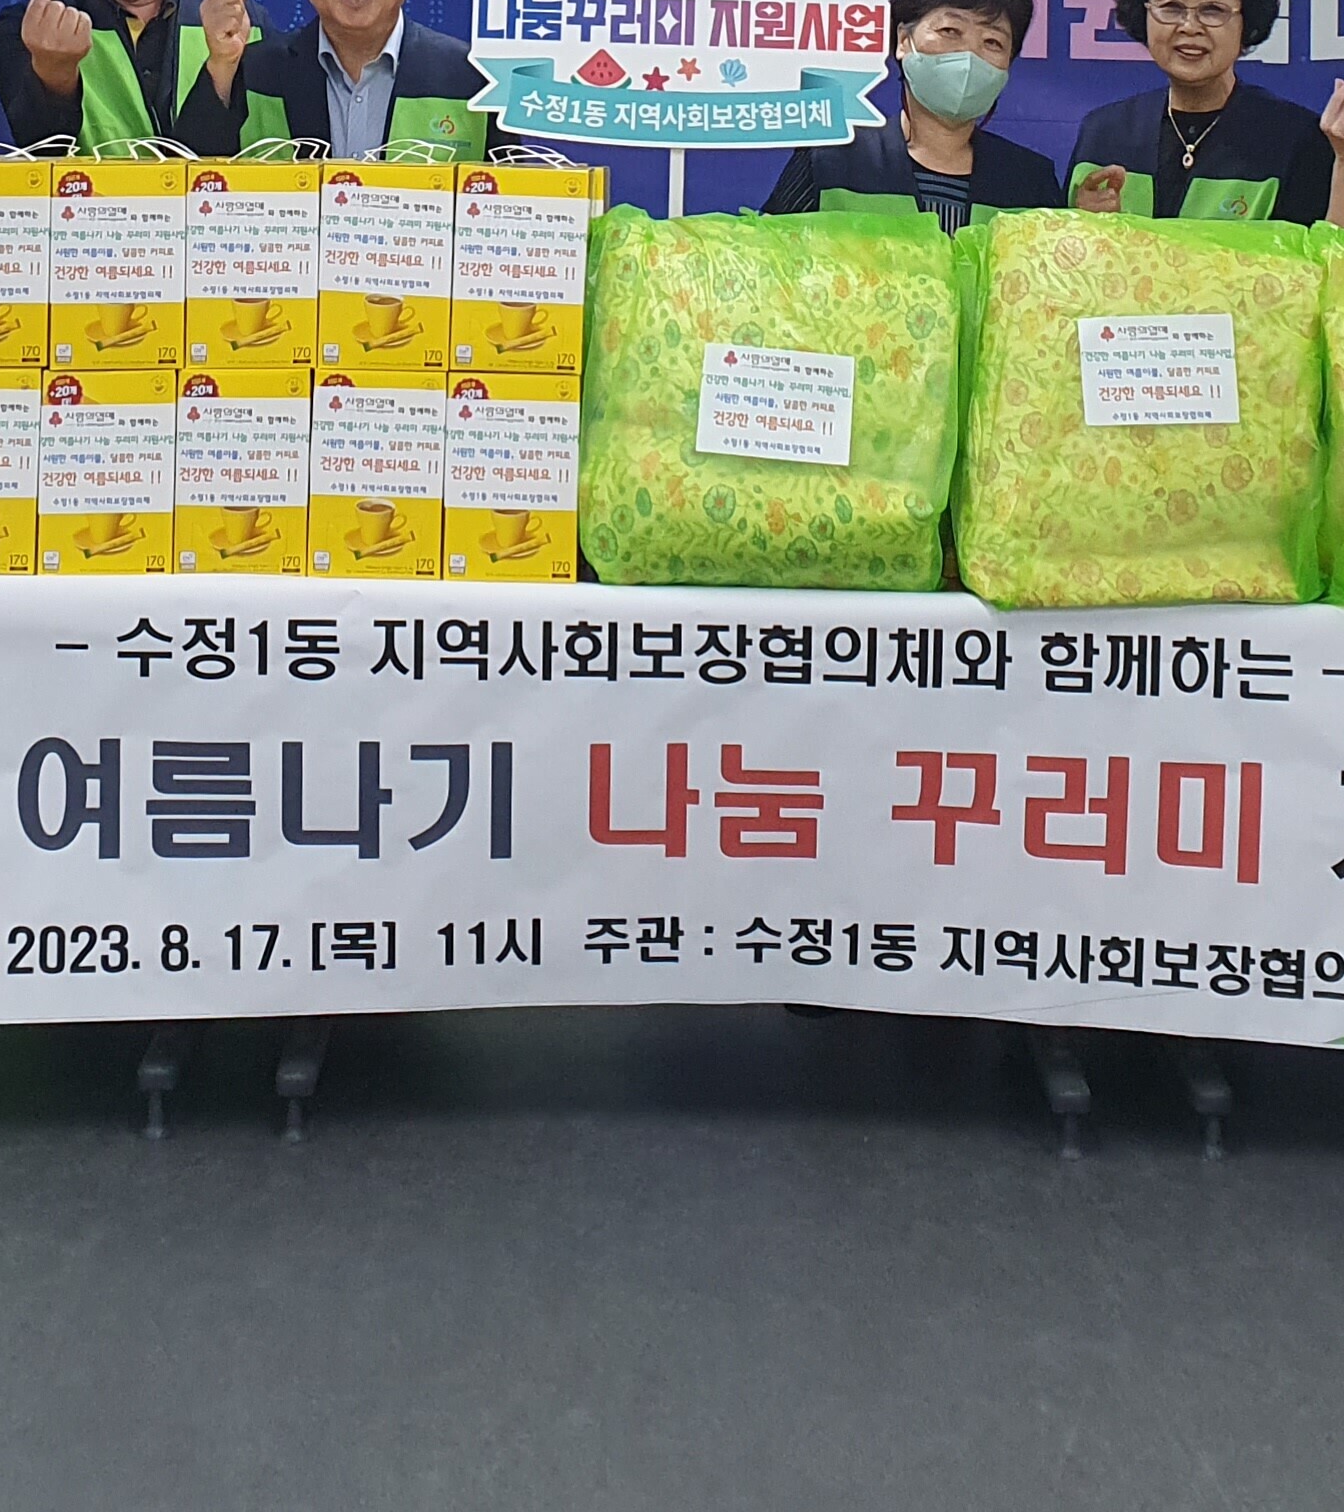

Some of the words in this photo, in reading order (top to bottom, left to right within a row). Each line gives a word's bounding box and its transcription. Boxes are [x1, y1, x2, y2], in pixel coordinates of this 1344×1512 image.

[708, 0, 885, 52] 지원사업
[520, 91, 607, 127] 수정1동
[615, 98, 832, 130] 지역사회보장협의체
[326, 250, 359, 265] 건강한
[55, 265, 89, 281] 건강한
[193, 260, 226, 275] 건강한
[459, 262, 492, 277] 건강한
[21, 346, 42, 358] 170
[157, 347, 178, 359] 170
[292, 347, 313, 359] 170
[423, 350, 444, 362] 170
[556, 354, 577, 366] 170
[1099, 387, 1135, 402] 건강한
[714, 411, 748, 427] 건강한
[756, 415, 815, 432] 여름되세요
[321, 457, 355, 471] 건강한
[43, 471, 77, 488] 건강한
[180, 467, 214, 482] 건강한
[452, 466, 485, 480] 건강한
[9, 555, 30, 567] 170
[145, 556, 166, 568] 170
[281, 556, 302, 568] 170
[415, 559, 436, 571] 170
[551, 562, 572, 574] 170
[117, 618, 340, 681] 수정1동
[371, 618, 1013, 690] 지역사회보장협의체와
[1041, 632, 1293, 701] 함께하는
[18, 737, 512, 859] 여름나기
[589, 743, 824, 858] 나눔
[892, 751, 1263, 884] 꾸러미
[7, 925, 140, 974] 2023.
[161, 924, 200, 972] 8.
[225, 925, 291, 970] 17.
[312, 921, 396, 971] [목]
[438, 918, 540, 965] 11시
[584, 916, 684, 964] 주관
[704, 926, 713, 955] :
[736, 917, 916, 971] 수정1동
